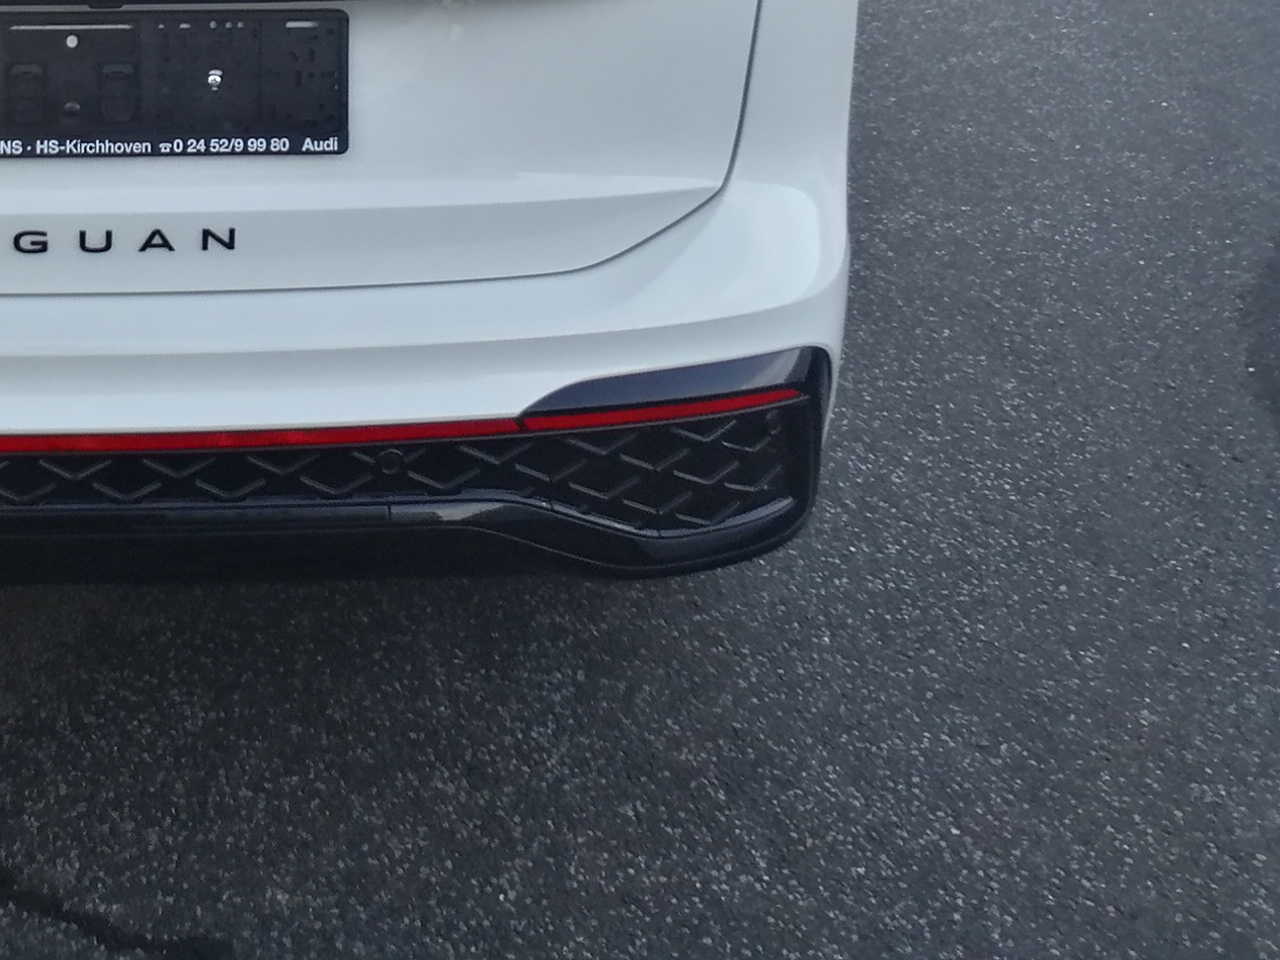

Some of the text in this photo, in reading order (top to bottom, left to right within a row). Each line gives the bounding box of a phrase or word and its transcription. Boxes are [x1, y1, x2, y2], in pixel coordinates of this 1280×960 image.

[36, 138, 151, 154] HS-Kirchhoven
[186, 138, 206, 153] 24
[209, 138, 244, 153] 52/9
[247, 137, 267, 152] 99
[270, 137, 290, 152] 80
[301, 136, 338, 152] Audi
